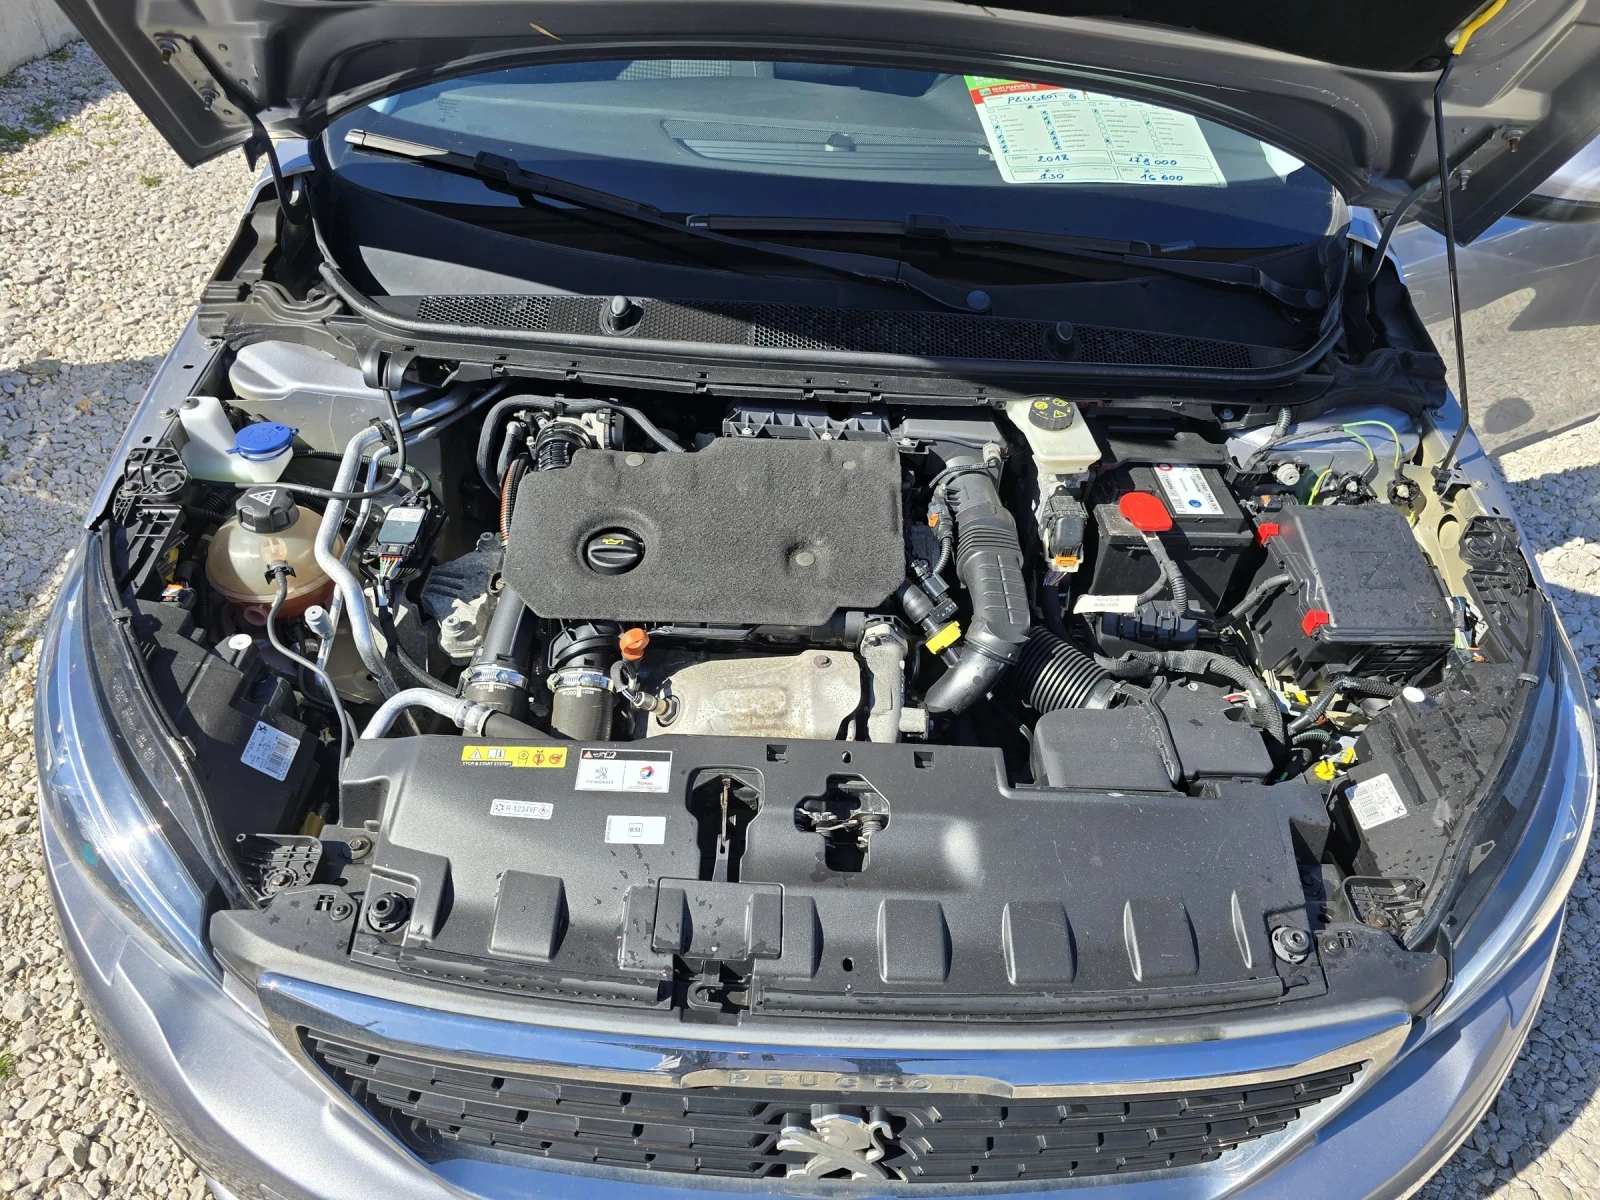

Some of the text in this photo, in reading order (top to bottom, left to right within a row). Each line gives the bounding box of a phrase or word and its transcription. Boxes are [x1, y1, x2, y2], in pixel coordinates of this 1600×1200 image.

[1008, 93, 1058, 105] PEUGEOT
[1161, 174, 1184, 182] 600
[728, 1073, 968, 1092] PEUGEOT
